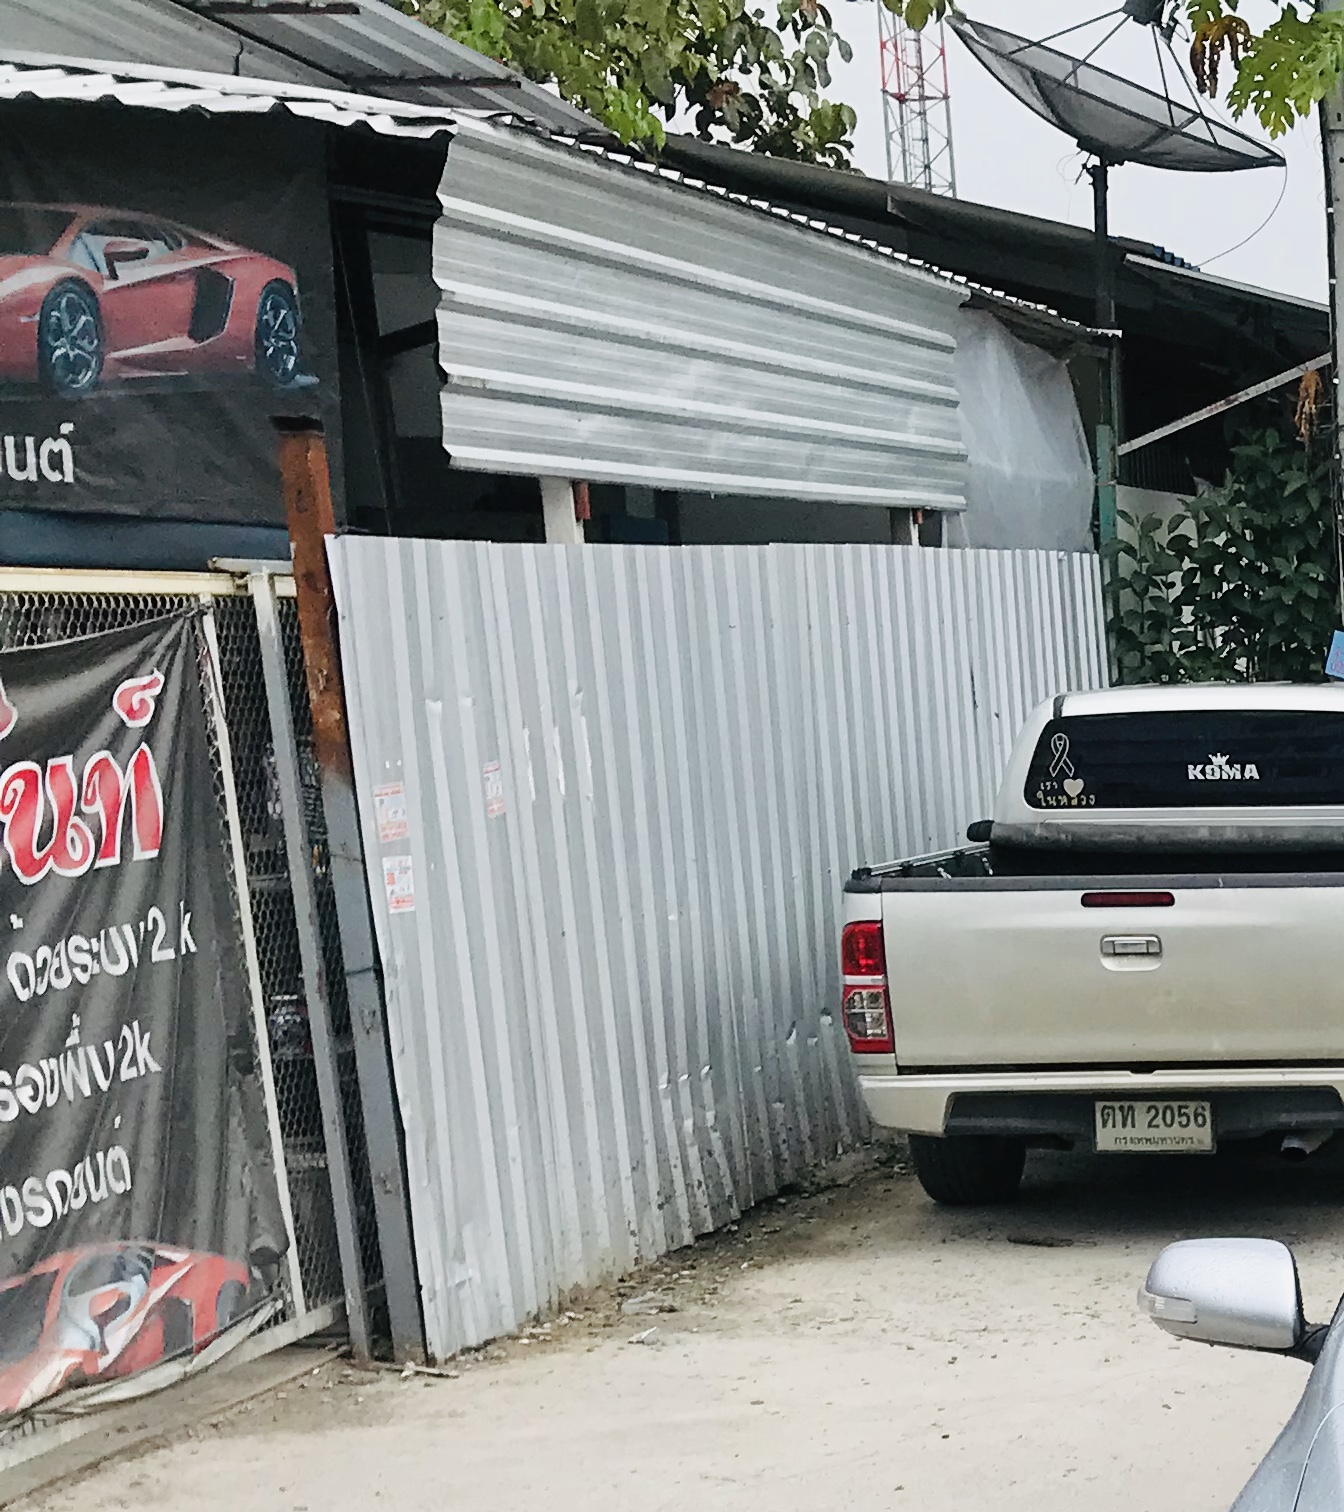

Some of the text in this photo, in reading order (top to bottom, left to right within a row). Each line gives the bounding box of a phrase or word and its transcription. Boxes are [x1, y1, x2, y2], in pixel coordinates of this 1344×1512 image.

[0, 422, 75, 483] นต์
[0, 667, 165, 886] นท์
[1188, 763, 1260, 780] KOMA
[1145, 1104, 1208, 1129] 2056
